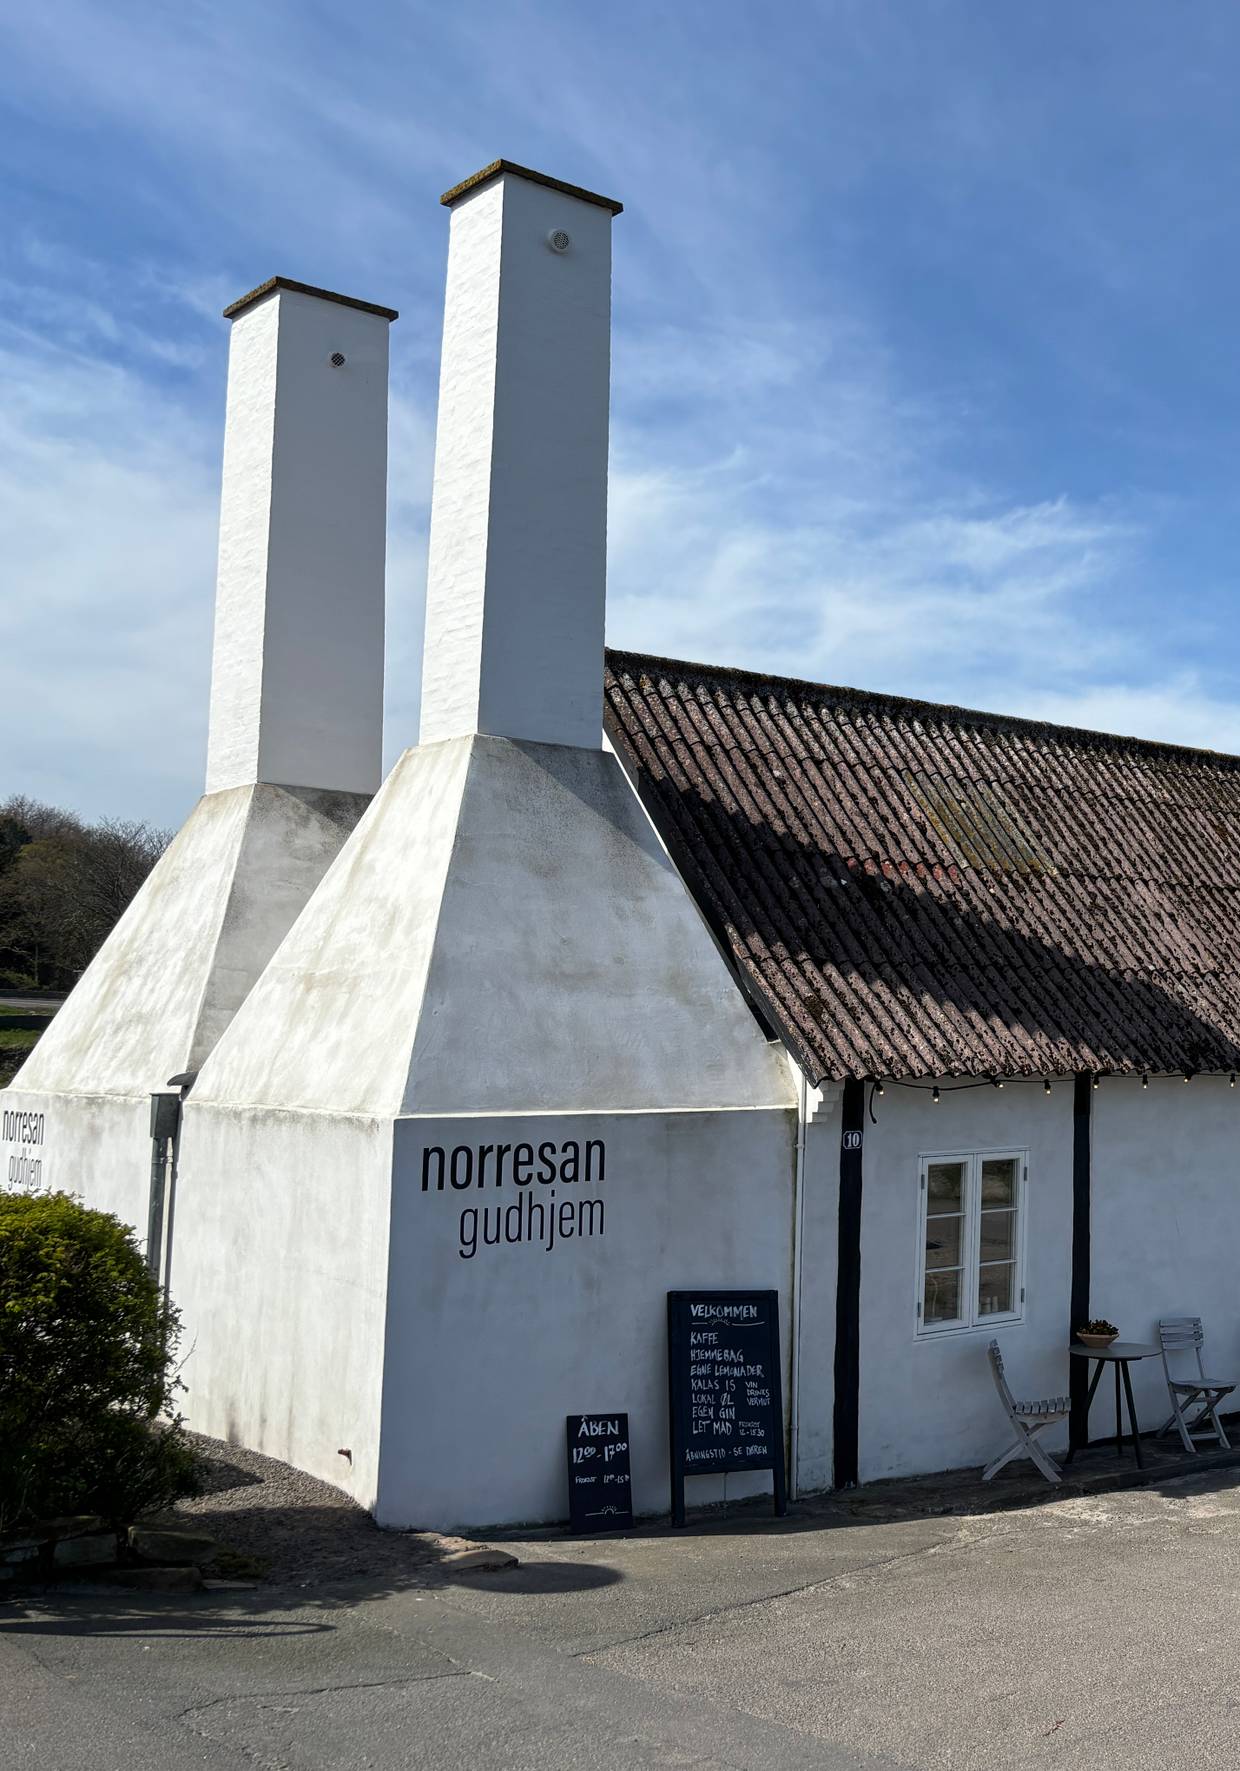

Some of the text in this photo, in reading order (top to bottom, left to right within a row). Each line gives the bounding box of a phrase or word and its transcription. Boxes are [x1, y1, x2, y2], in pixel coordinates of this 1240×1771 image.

[2, 1110, 45, 1146] norresan
[847, 1132, 860, 1148] 10
[8, 1147, 42, 1191] gudhjem
[421, 1139, 605, 1191] norresan
[459, 1189, 604, 1259] gudhjem
[690, 1304, 758, 1321] VELKOMMEN
[690, 1331, 719, 1347] KAFFE
[690, 1348, 744, 1363] HJEMMEBAG
[690, 1363, 765, 1378] EGNE LEMONADER
[691, 1379, 736, 1392] KALAS IS
[745, 1381, 758, 1389] VIN
[692, 1392, 735, 1406] LOKAL ØL
[692, 1406, 736, 1420] EGEN GIN
[578, 1415, 620, 1438] ÅBEN
[692, 1420, 733, 1436] LET MAD
[733, 1446, 743, 1457] SE
